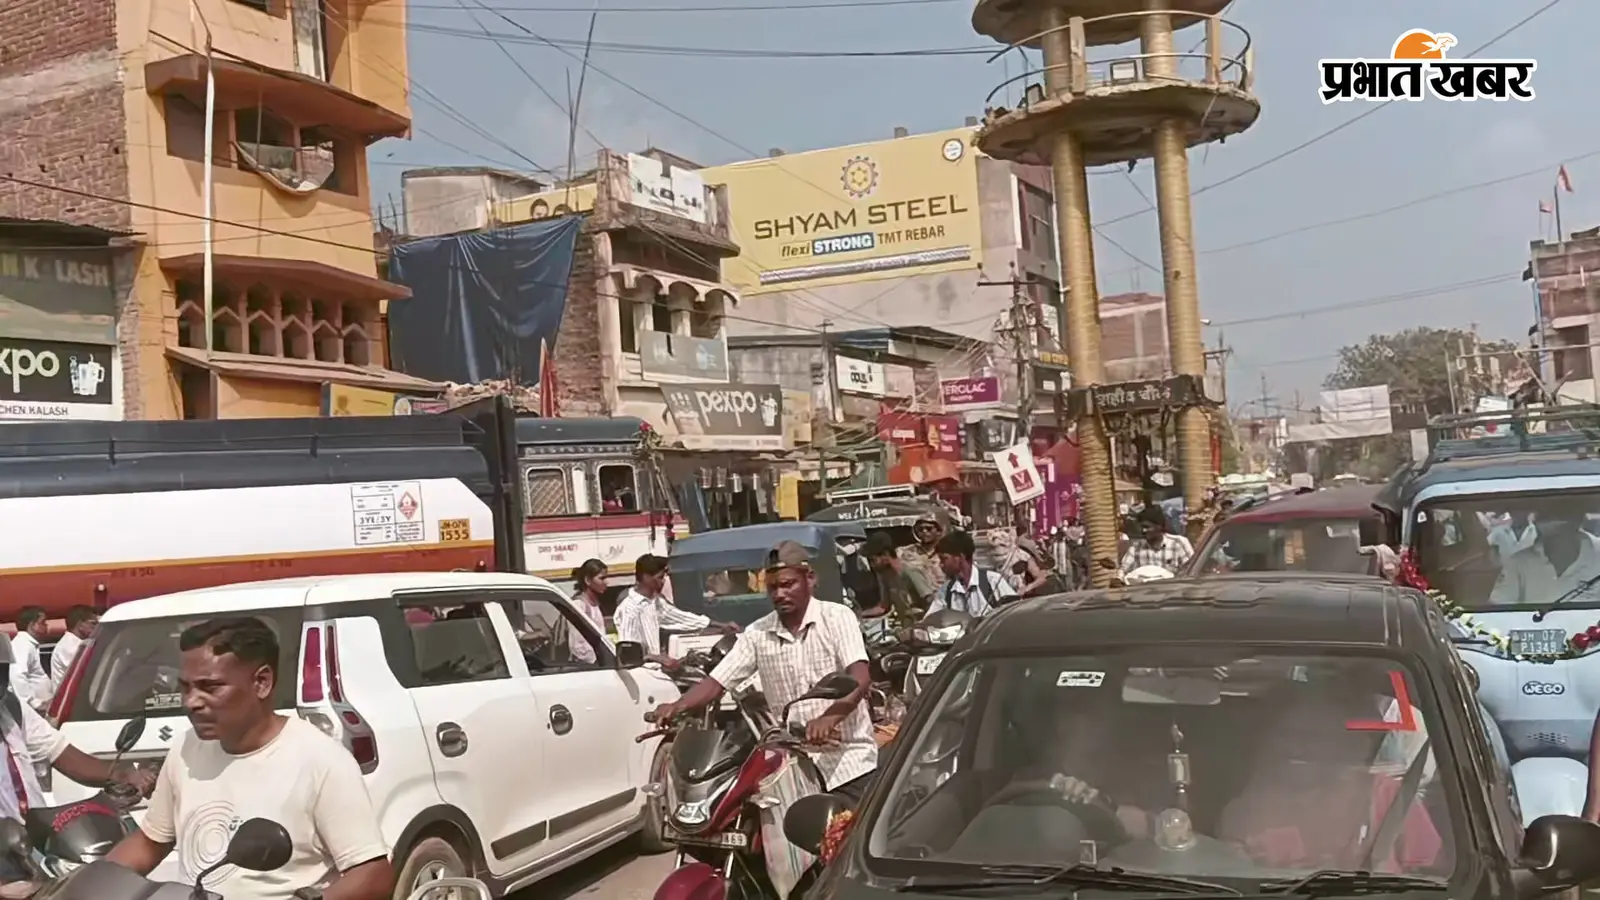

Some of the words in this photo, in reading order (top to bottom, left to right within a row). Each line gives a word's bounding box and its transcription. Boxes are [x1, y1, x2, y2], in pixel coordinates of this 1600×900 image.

[754, 208, 857, 240] SHYAM
[868, 194, 968, 225] STEEL
[781, 242, 811, 258] flexi
[814, 234, 874, 254] STRONG
[878, 231, 902, 245] TMT
[905, 225, 945, 241] REBAR
[29, 406, 69, 416] KALASH
[695, 390, 757, 428] pexpo
[1521, 632, 1534, 642] JH
[1523, 682, 1564, 696] WEGO
